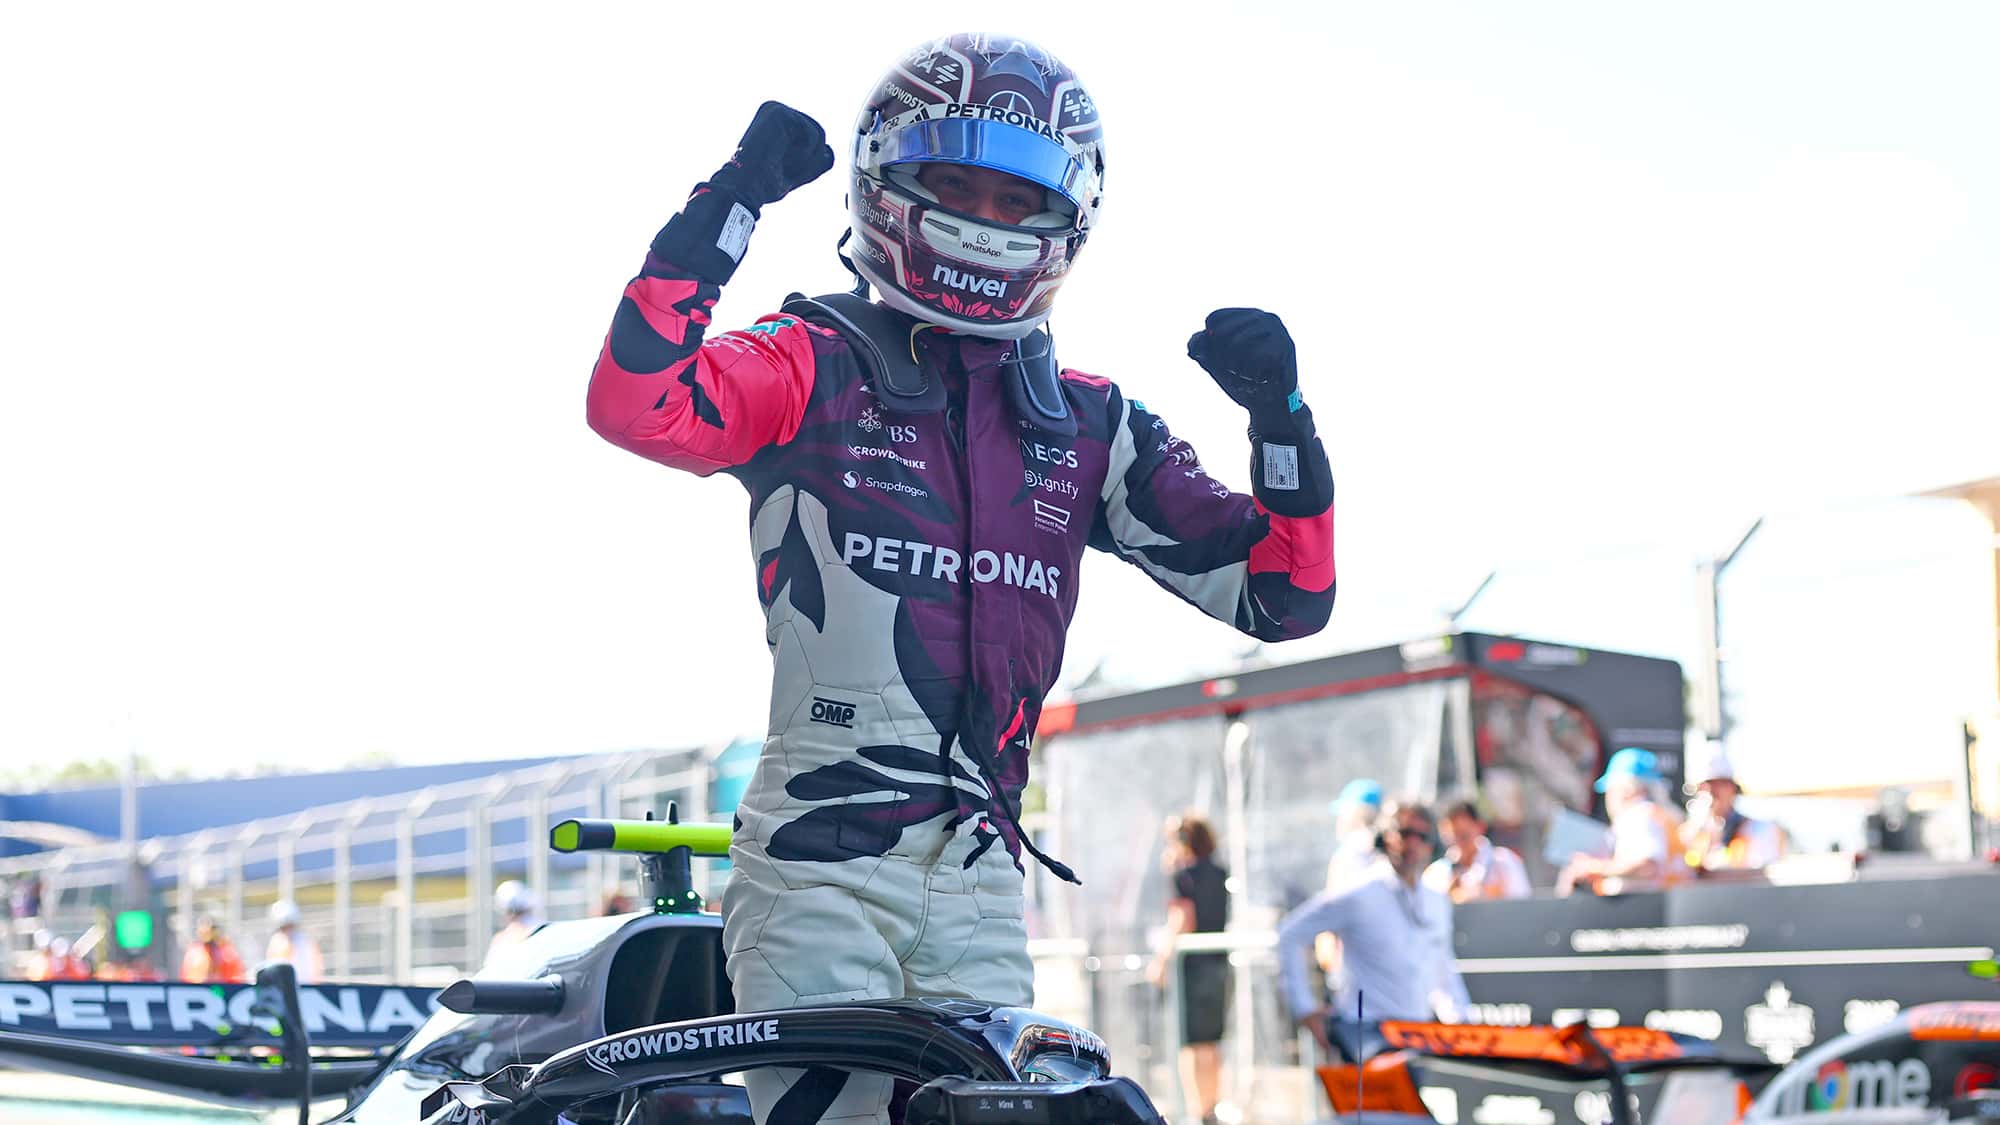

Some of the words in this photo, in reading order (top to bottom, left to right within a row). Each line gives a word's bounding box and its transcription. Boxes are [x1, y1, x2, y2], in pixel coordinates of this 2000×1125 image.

[945, 103, 1065, 147] PETRONAS
[962, 241, 1002, 257] WhatsApp
[932, 263, 1009, 298] nuvei
[865, 476, 928, 499] Snapdragon
[1025, 469, 1079, 500] Signify
[843, 532, 1061, 600] PETRONAS
[811, 702, 856, 724] OMP
[0, 984, 445, 1032] PETRONA
[589, 1019, 780, 1067] CROWDSTRIKE
